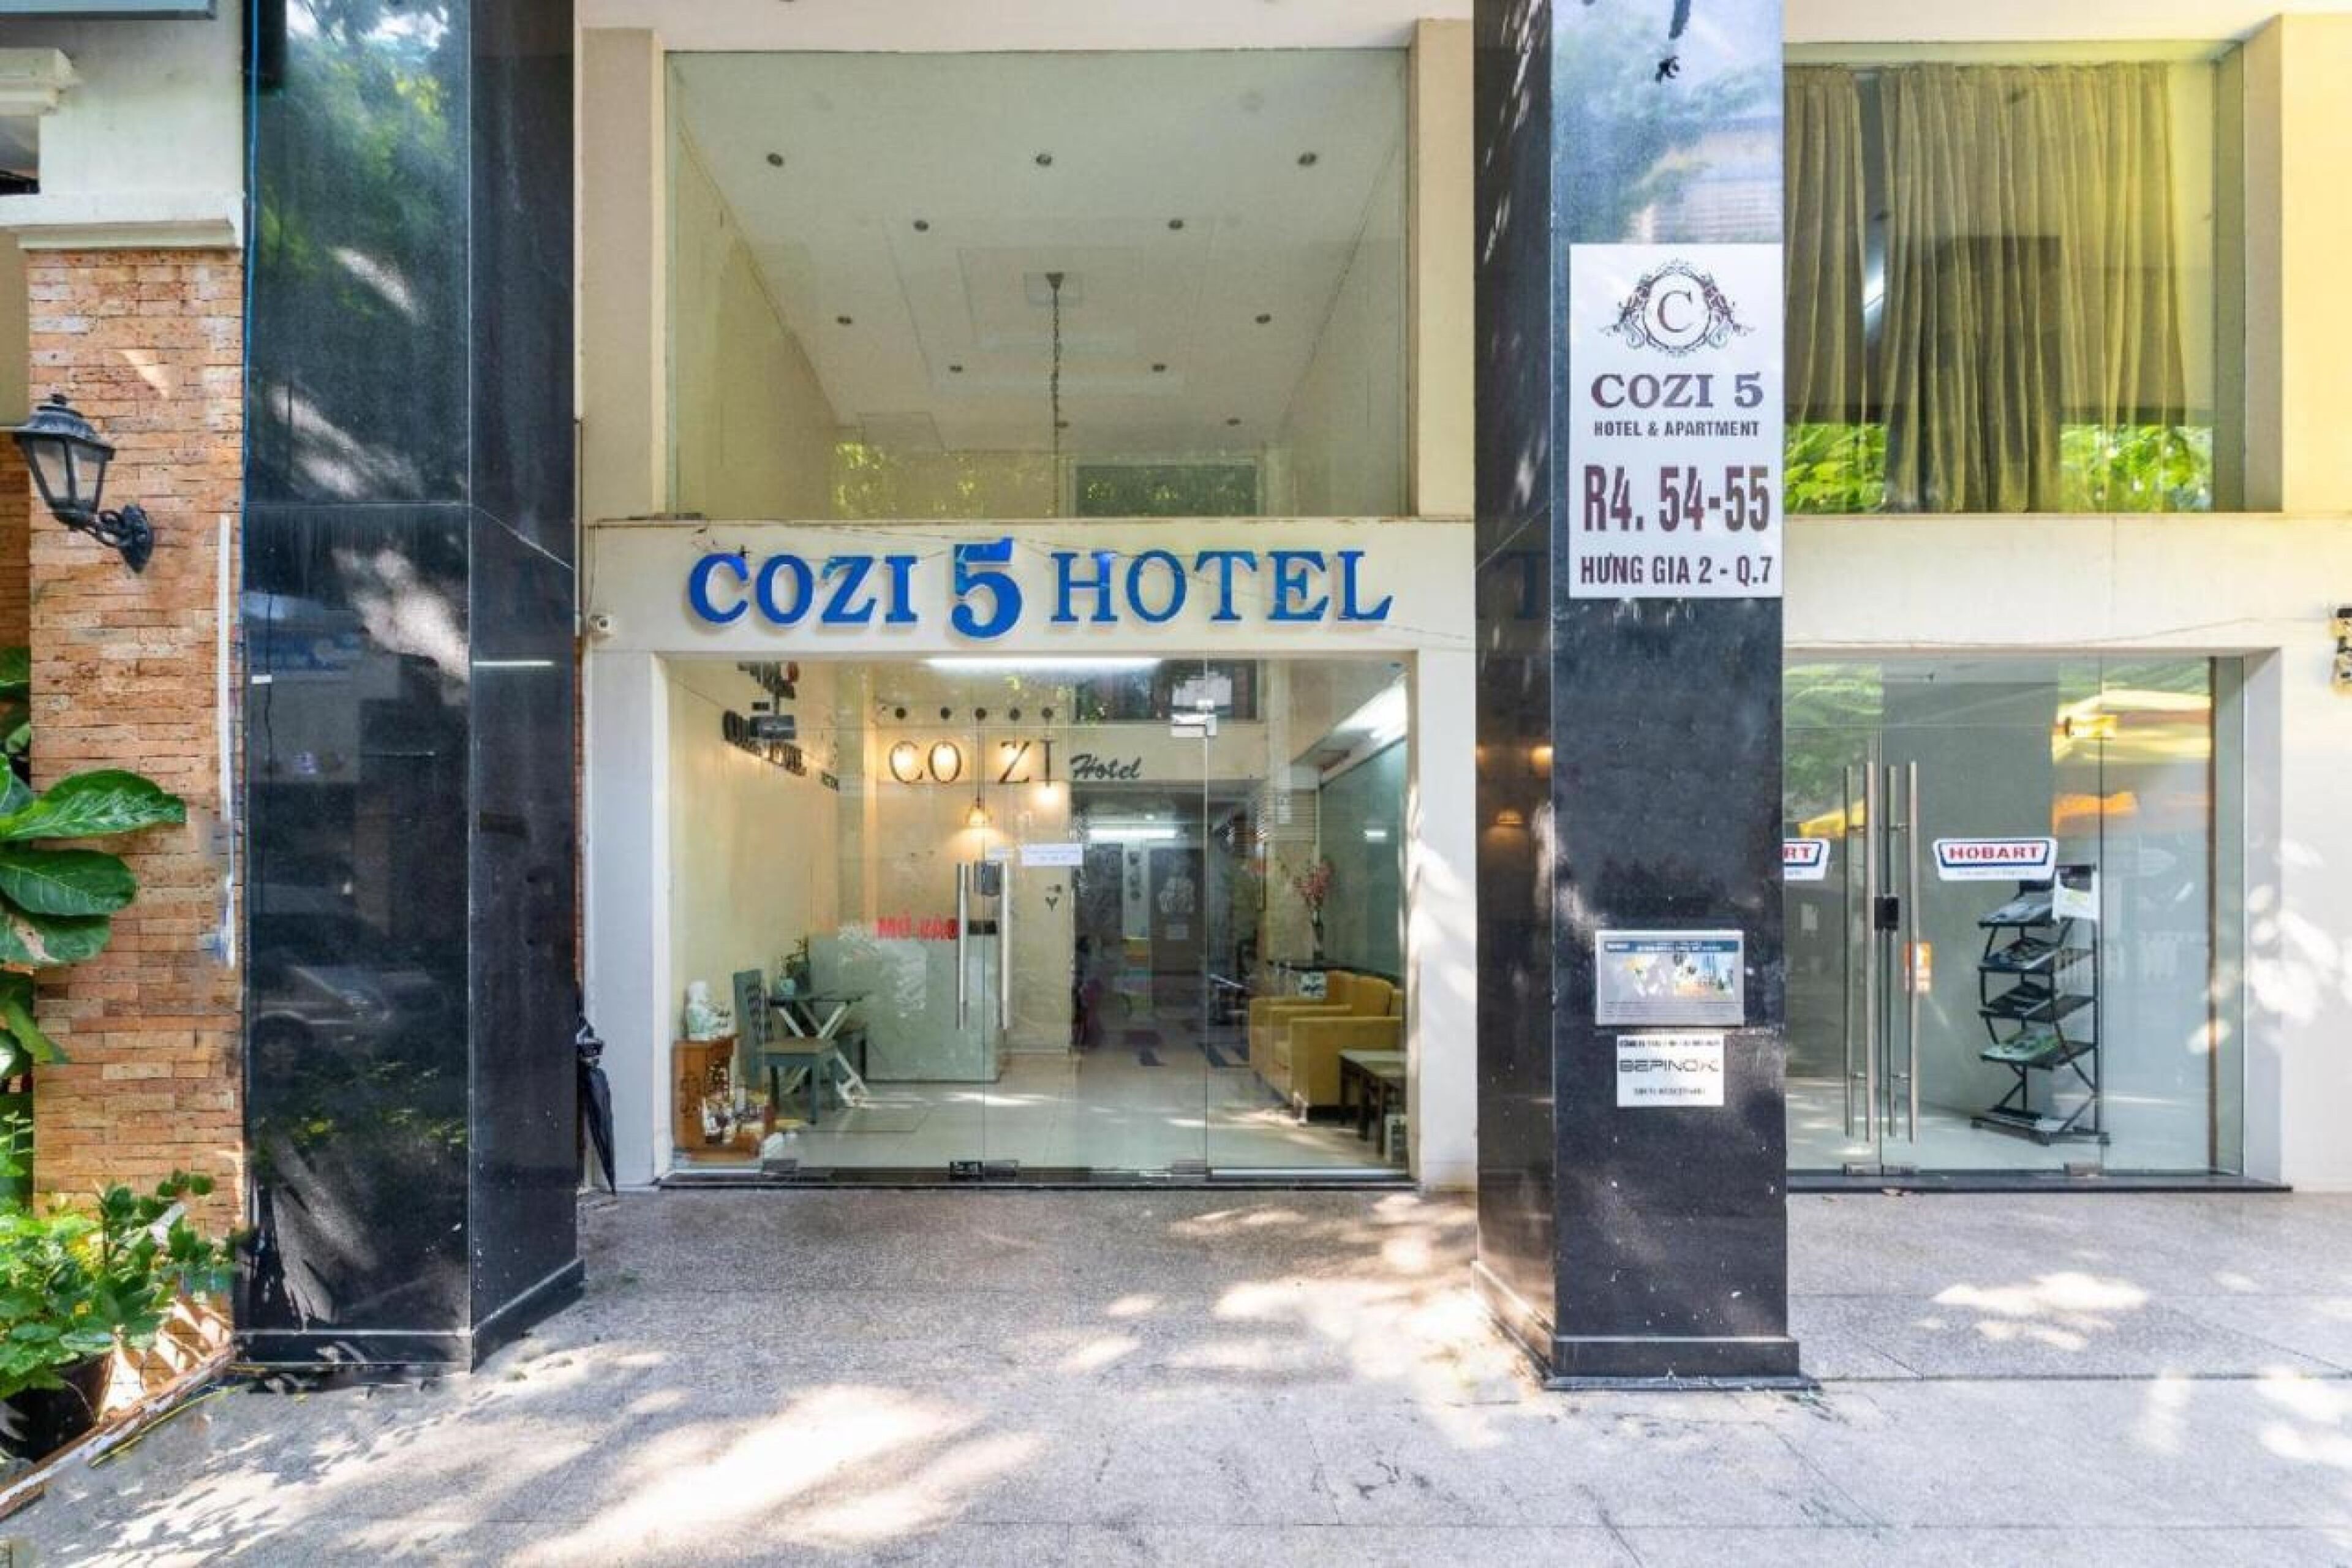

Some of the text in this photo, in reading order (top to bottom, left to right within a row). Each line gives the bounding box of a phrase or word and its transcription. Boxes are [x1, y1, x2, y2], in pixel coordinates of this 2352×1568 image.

[1657, 290, 1693, 333] C
[1591, 371, 1764, 409] COZI 5
[1594, 421, 1760, 437] HOTEL & APARTMENT
[1584, 465, 1770, 532] R4. 54-55
[1580, 551, 1644, 584] HƯNG
[1652, 555, 1691, 584] GIA
[1698, 555, 1713, 584] 2
[1736, 555, 1773, 587] Q.7
[687, 537, 1393, 639] COZI 5 HOTEL
[1069, 753, 1142, 780] Hotel
[1948, 846, 2040, 860] HOBART
